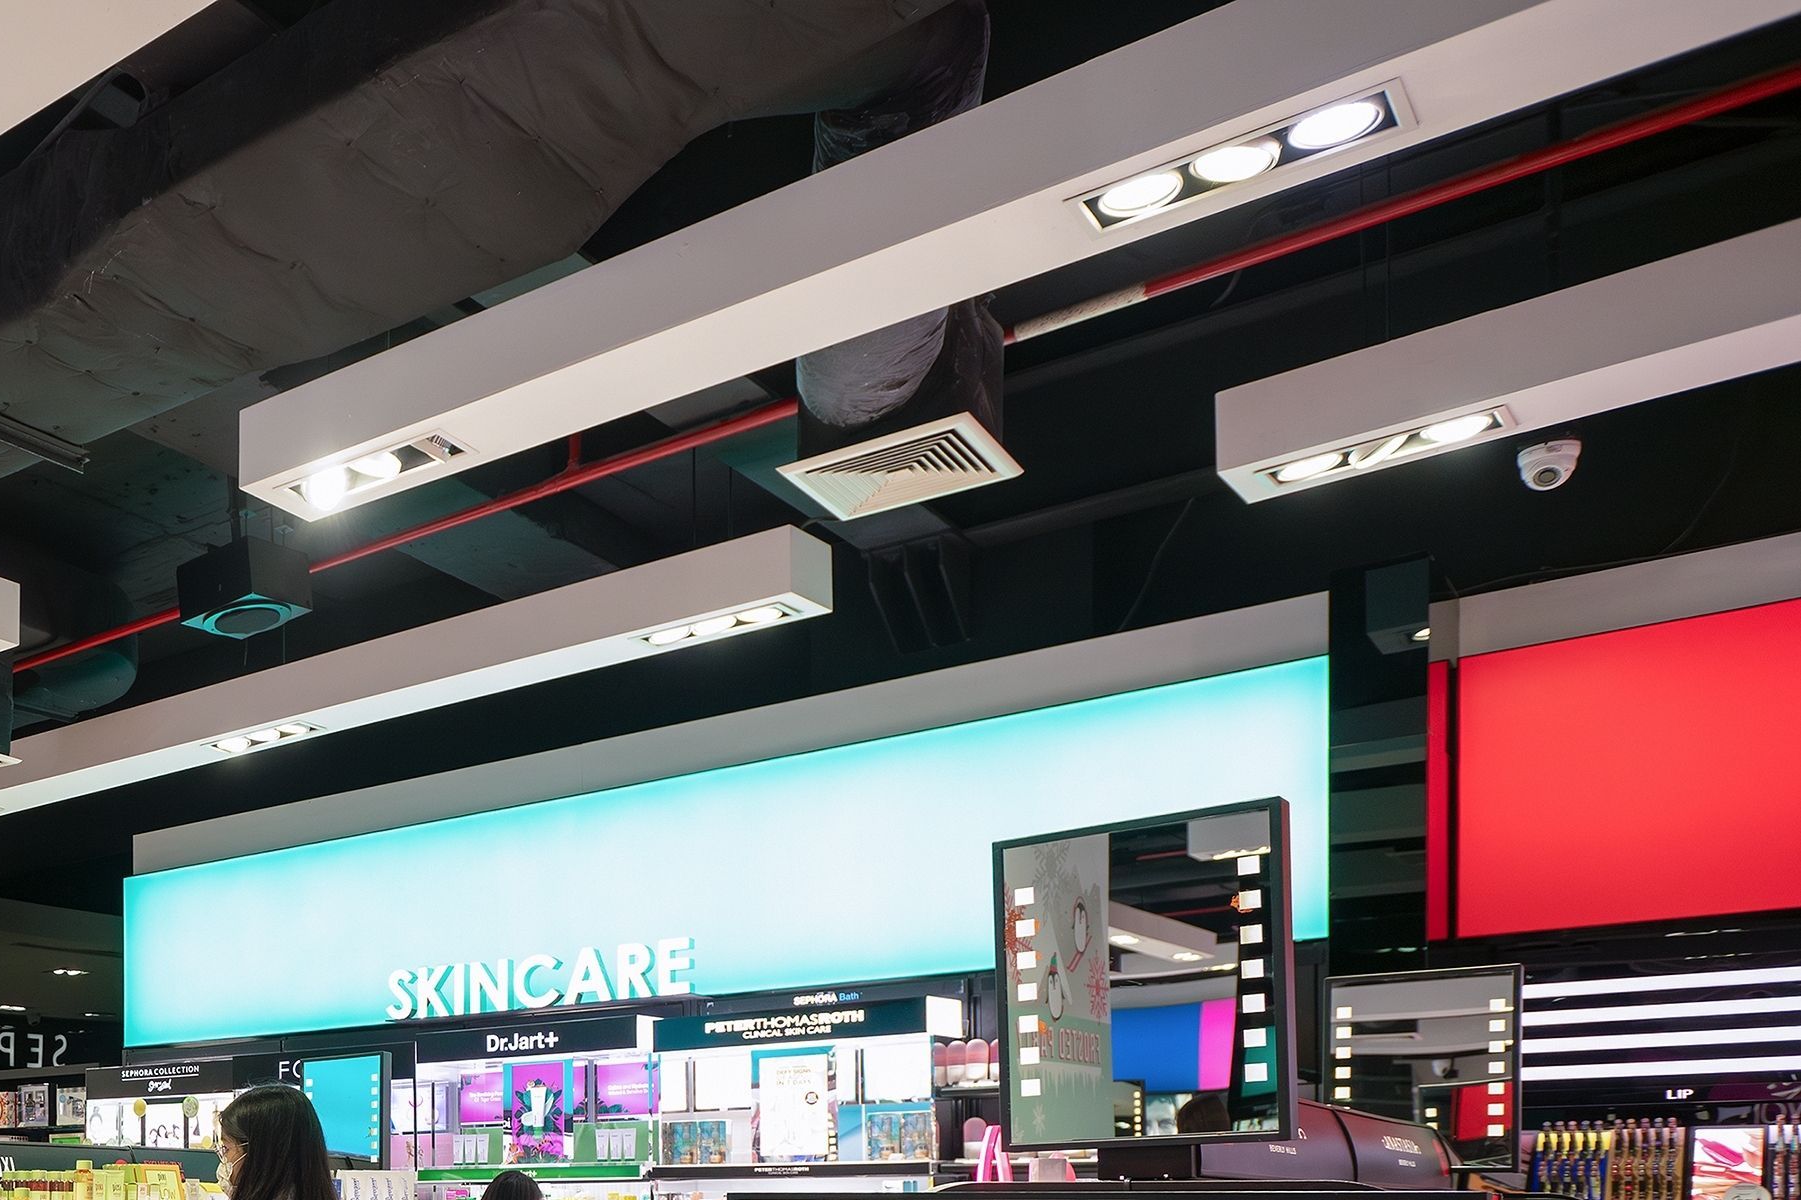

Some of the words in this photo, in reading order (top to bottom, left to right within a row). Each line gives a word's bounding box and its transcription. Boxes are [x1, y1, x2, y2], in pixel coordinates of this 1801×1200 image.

[385, 937, 695, 1021] SKINCARE
[839, 992, 860, 1002] Bath
[742, 1027, 784, 1040] CLINICAL
[785, 1026, 805, 1037] SKIN
[806, 1024, 832, 1034] CARE
[486, 1031, 559, 1052] Dr.Jart+
[121, 1067, 153, 1079] SEPHORA
[153, 1064, 200, 1076] COLLECTION
[1665, 1088, 1694, 1100] LIP
